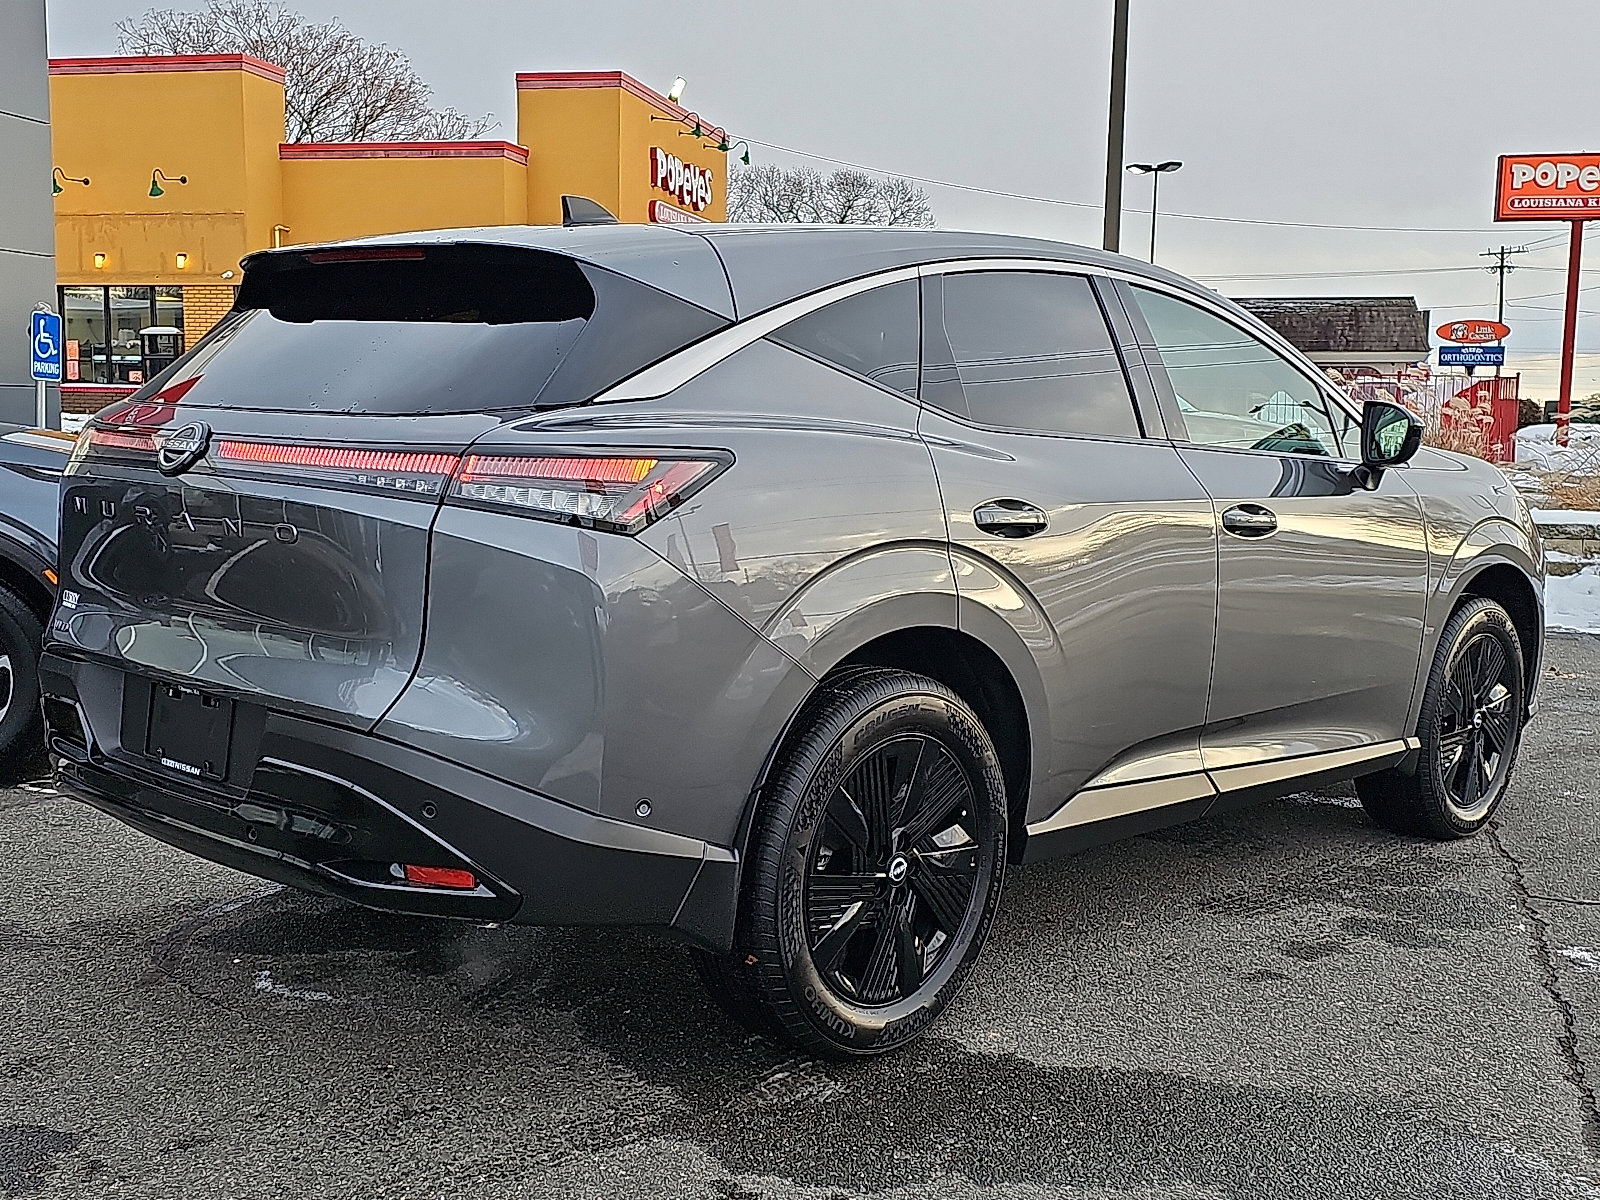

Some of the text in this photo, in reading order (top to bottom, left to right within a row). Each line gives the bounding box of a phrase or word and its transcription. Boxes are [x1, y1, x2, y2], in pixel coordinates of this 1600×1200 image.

[1511, 161, 1600, 191] POPe
[1513, 198, 1584, 208] LOUISIANA
[1475, 325, 1494, 334] Little
[1440, 353, 1503, 362] ORTHODONTICS
[33, 361, 60, 375] PARKING
[804, 985, 857, 1039] KUMHO
